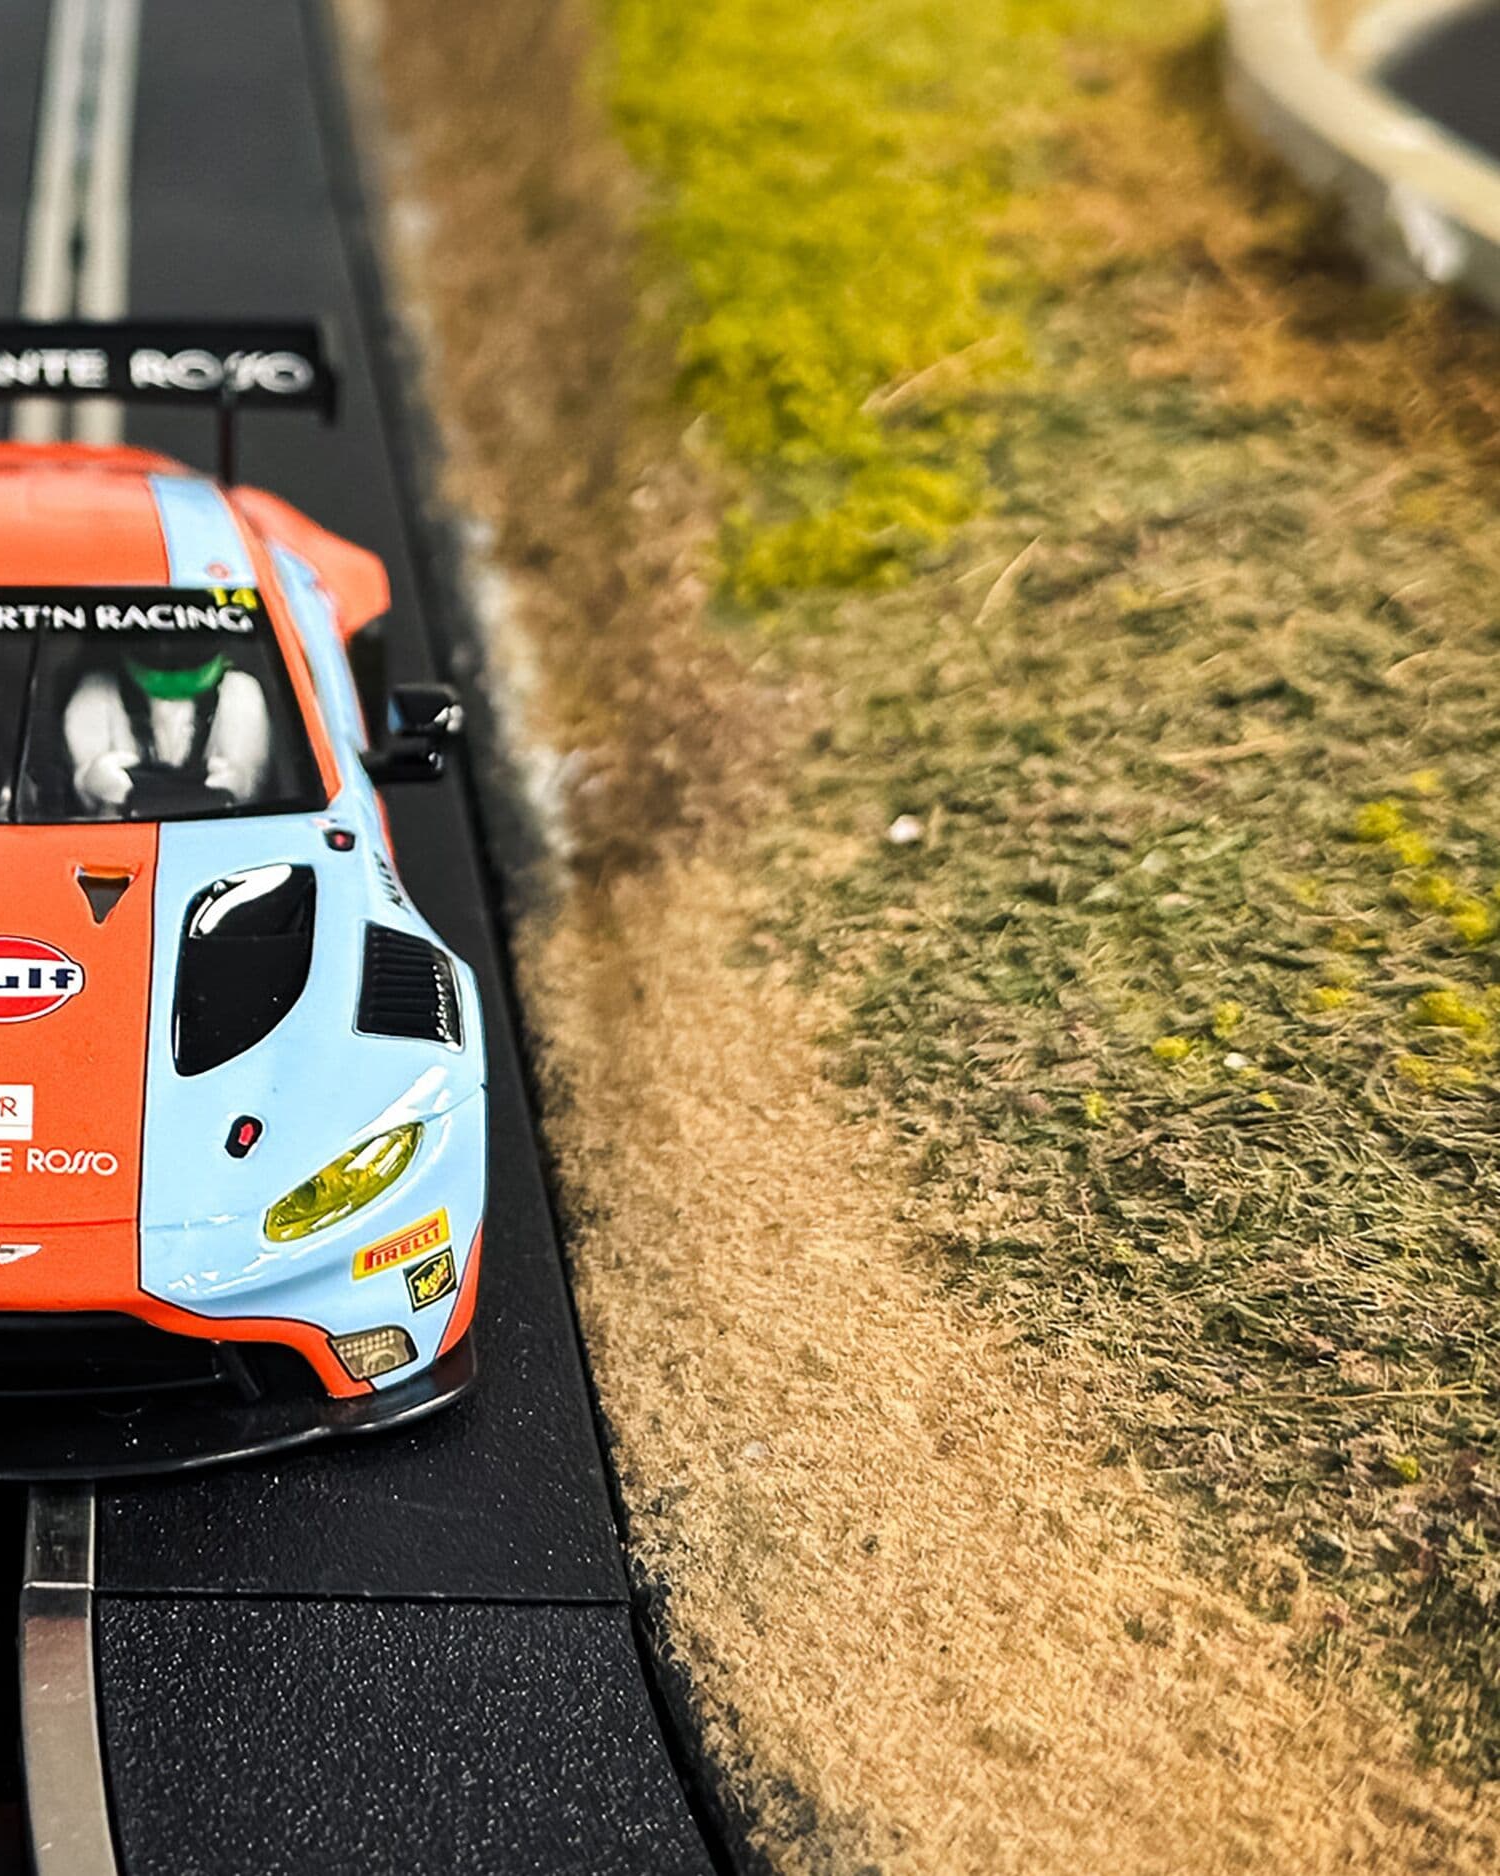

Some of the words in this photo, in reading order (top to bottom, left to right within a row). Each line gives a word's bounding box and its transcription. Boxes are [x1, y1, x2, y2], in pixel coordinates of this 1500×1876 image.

[95, 604, 255, 633] RACING
[26, 1149, 119, 1176] ROSSO
[363, 1218, 440, 1271] PIRELLI
